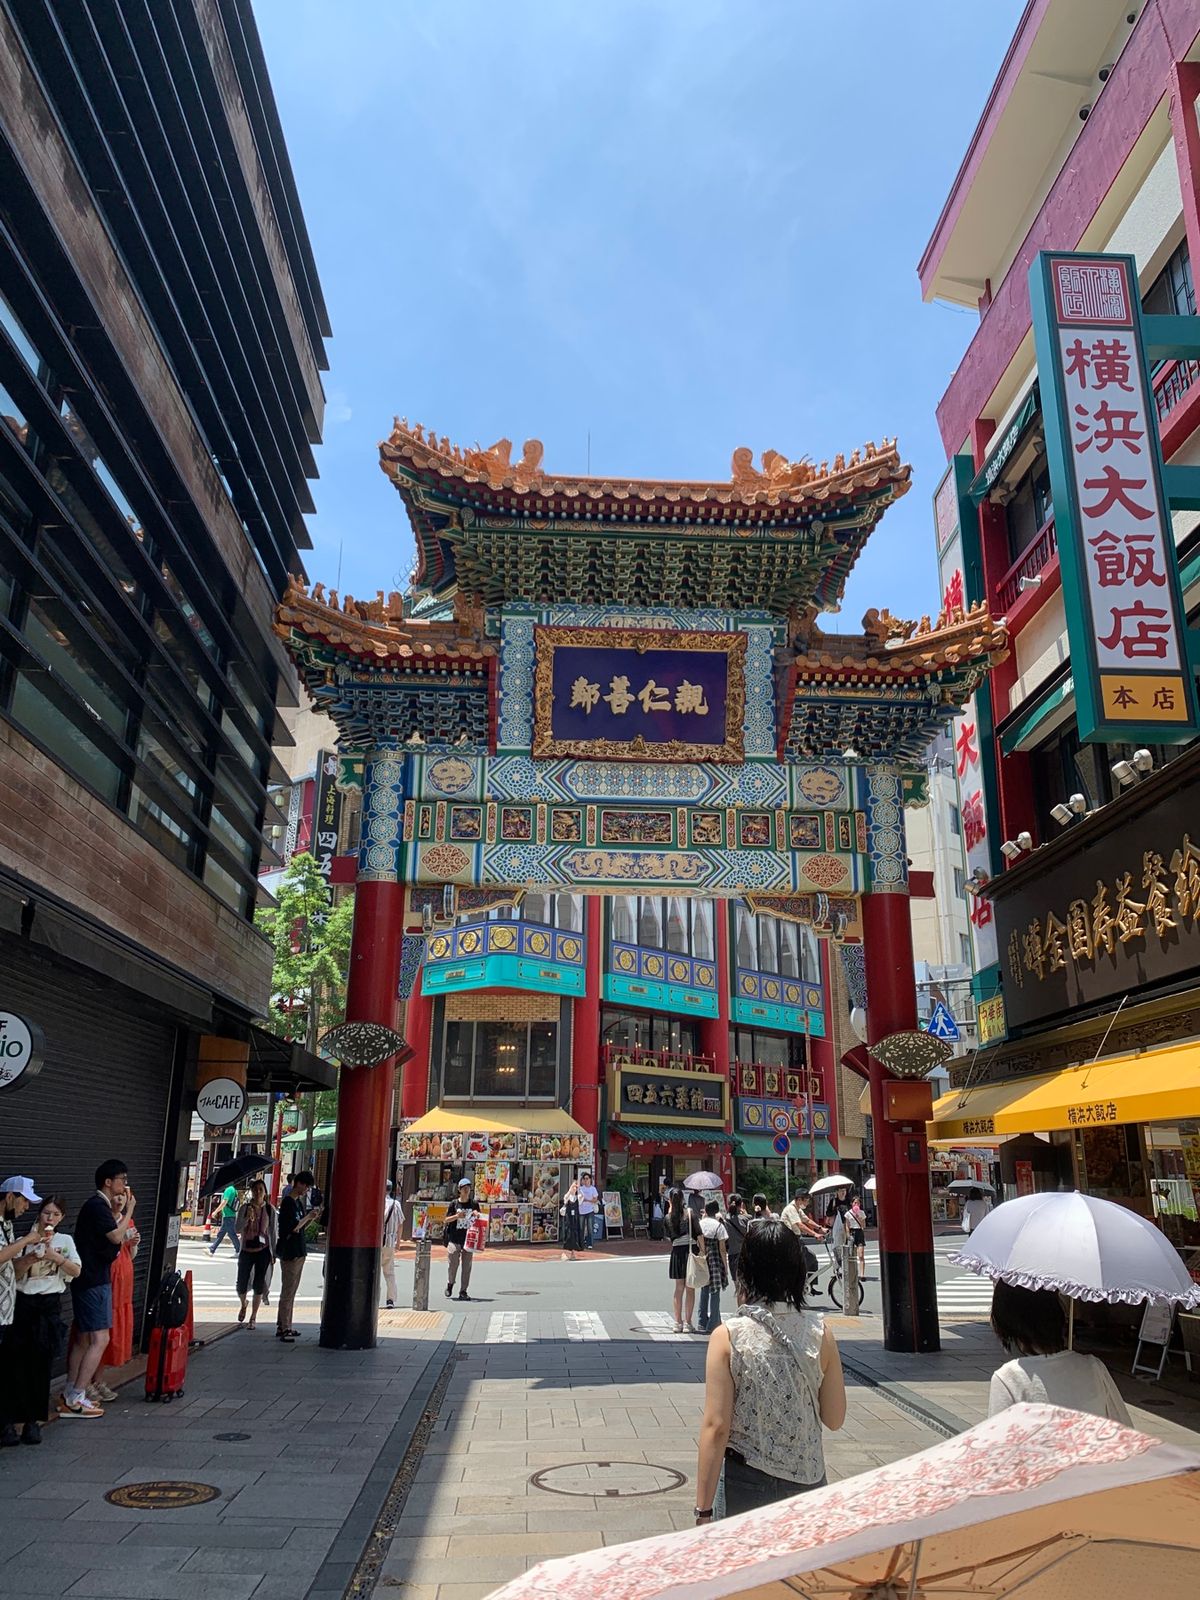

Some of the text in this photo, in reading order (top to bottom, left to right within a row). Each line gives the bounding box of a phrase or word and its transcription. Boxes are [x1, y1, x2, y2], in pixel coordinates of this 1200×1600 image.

[1063, 337, 1172, 659] 横浜大飯店
[1112, 685, 1176, 711] 本店
[0, 1034, 24, 1058] io
[199, 1095, 242, 1110] The CAFE
[626, 1083, 705, 1111] 四五六菜館
[776, 1117, 787, 1128] 30
[1067, 1101, 1118, 1126] 横浜大飯店
[962, 1119, 995, 1135] 横浜大飯店
